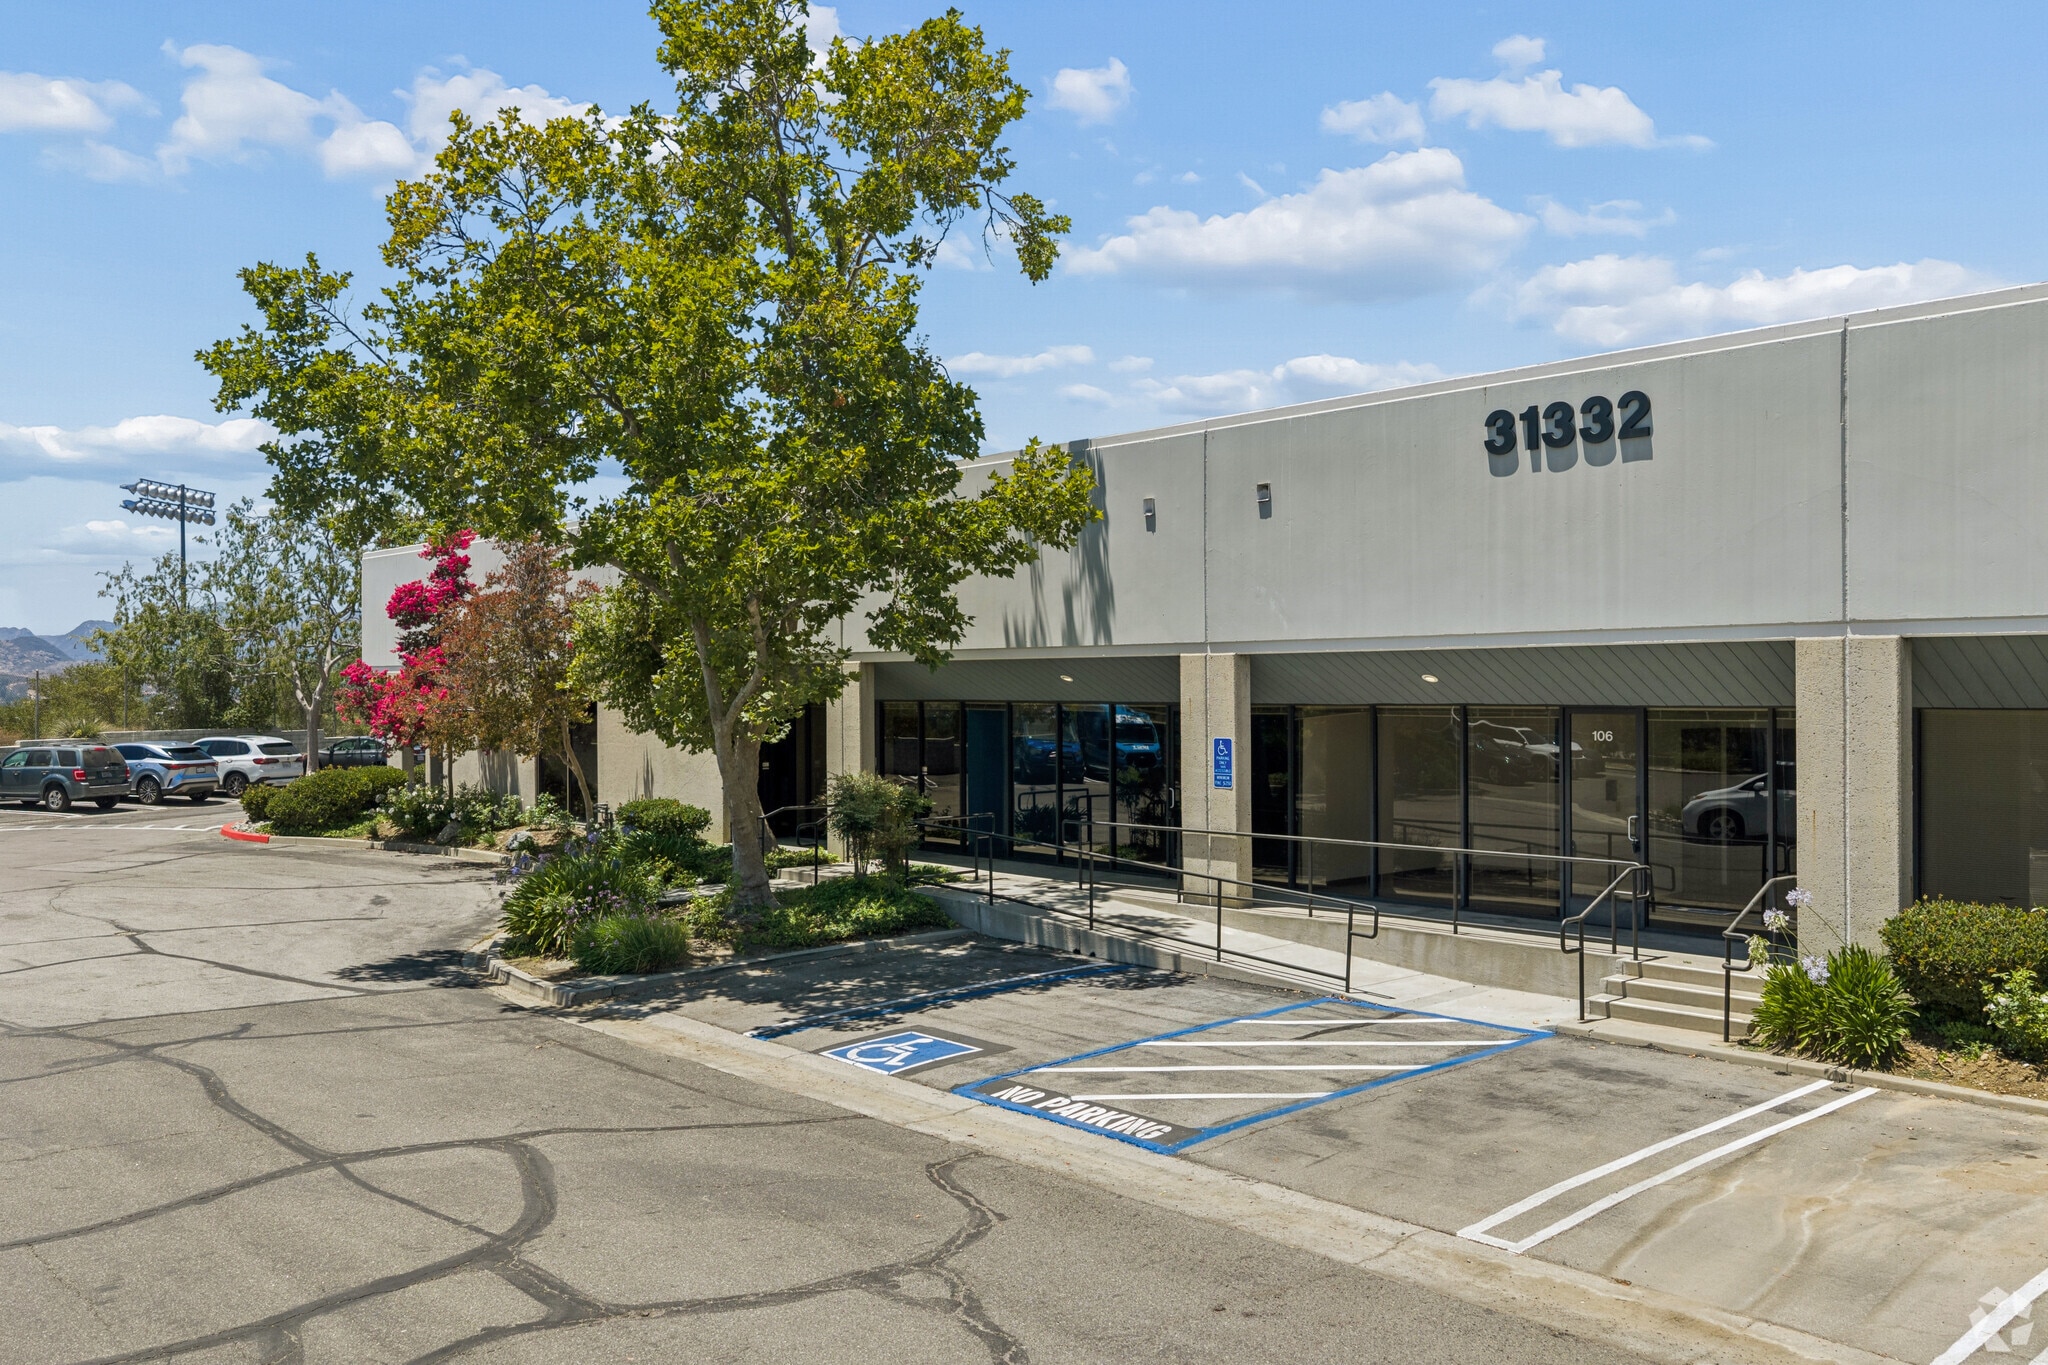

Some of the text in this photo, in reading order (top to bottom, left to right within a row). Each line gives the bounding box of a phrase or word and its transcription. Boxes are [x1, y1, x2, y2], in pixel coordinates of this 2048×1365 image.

[1484, 390, 1652, 456] 31332
[1592, 730, 1614, 742] 106
[990, 1085, 1173, 1140] NO PARKING
